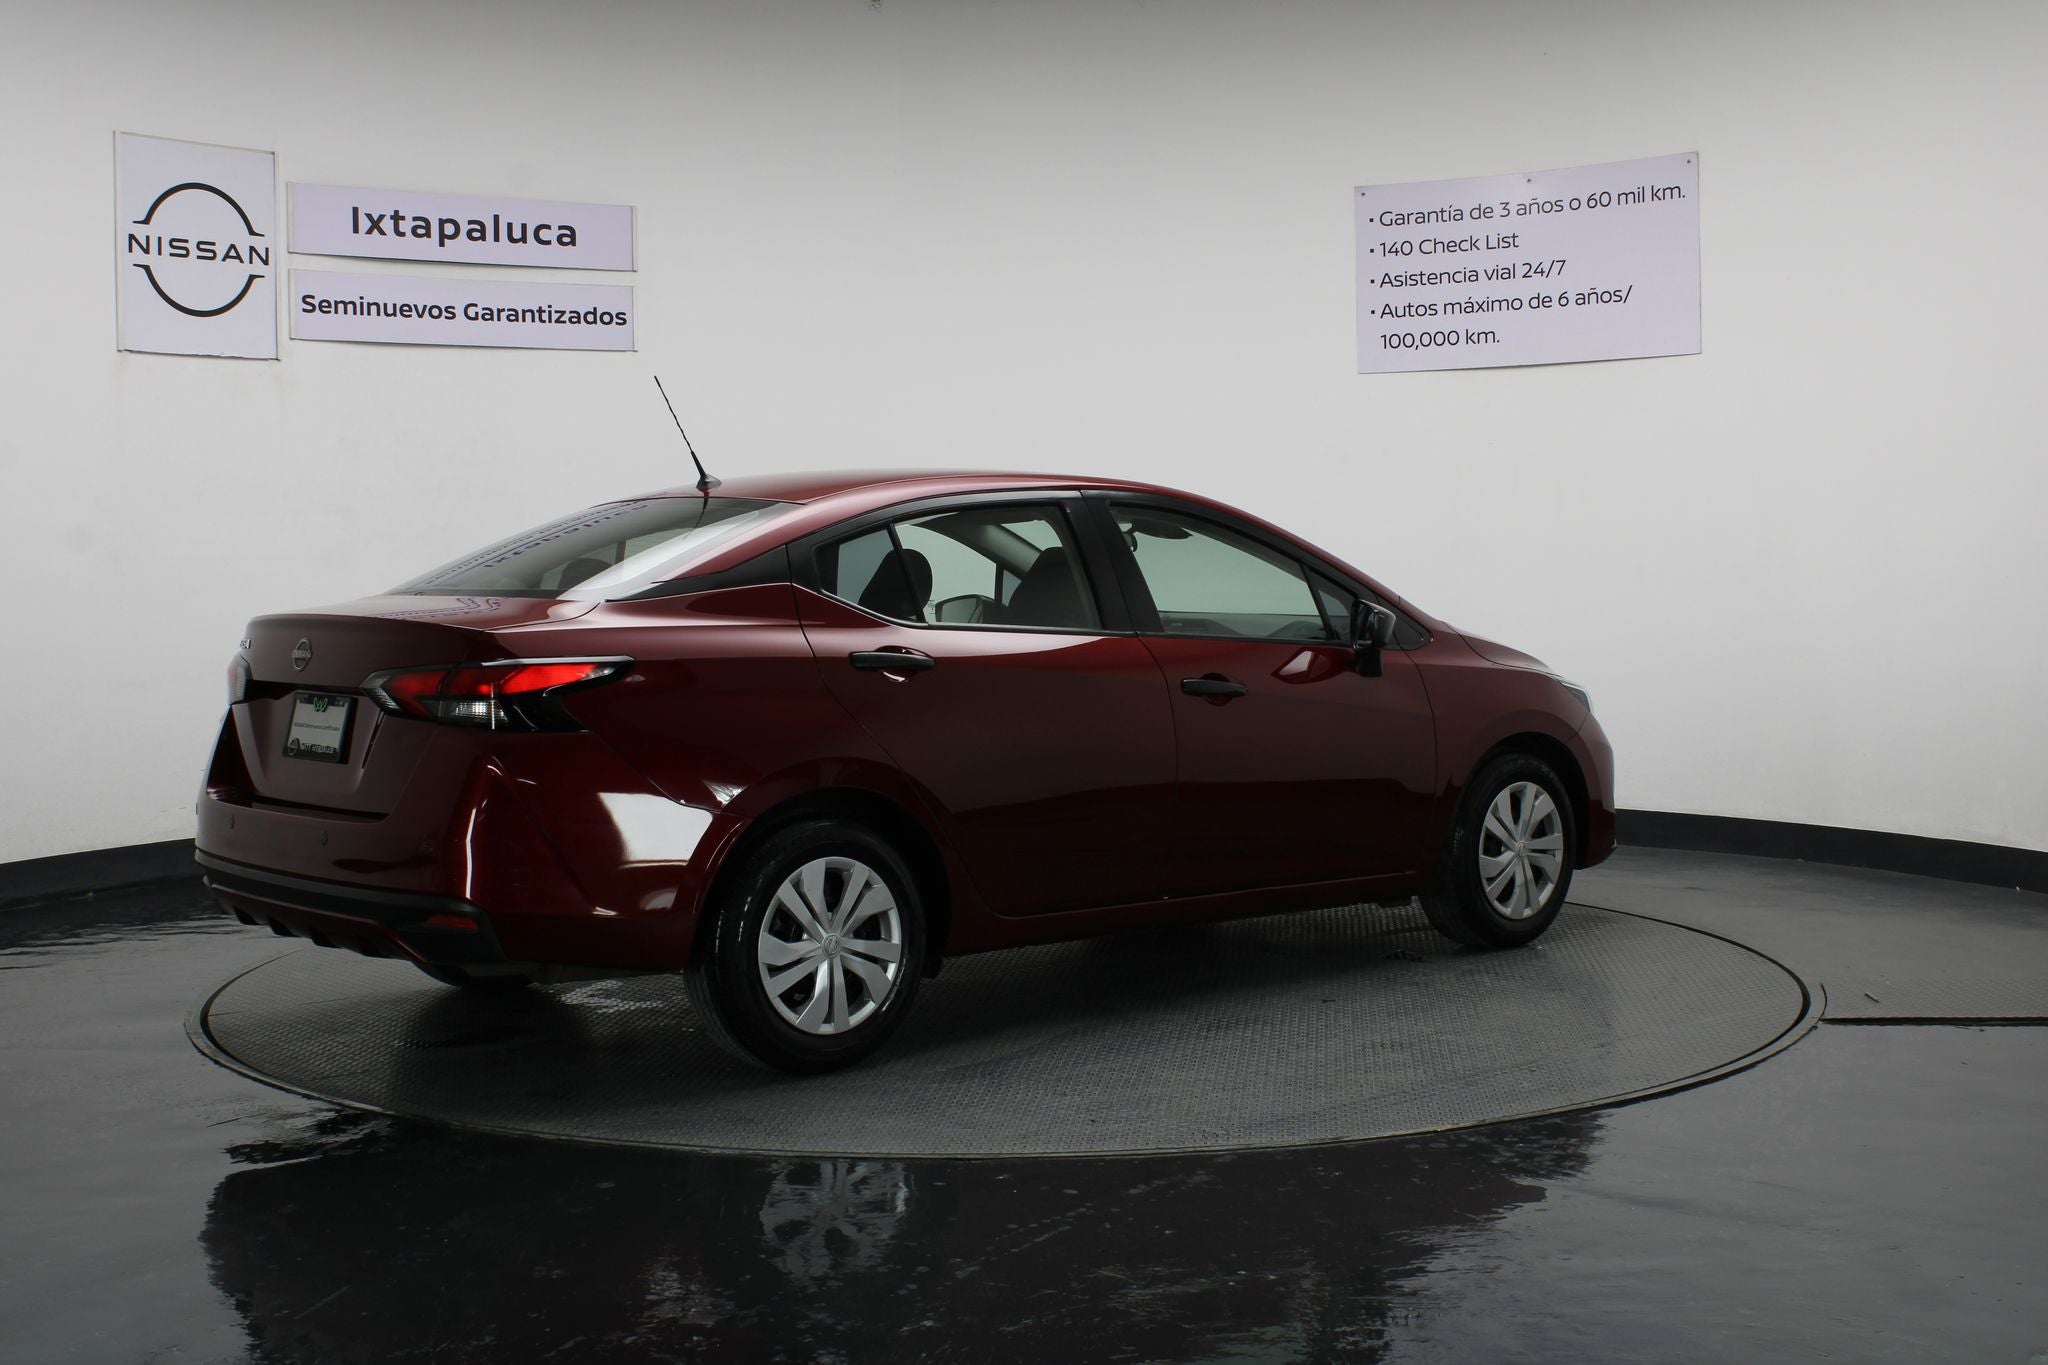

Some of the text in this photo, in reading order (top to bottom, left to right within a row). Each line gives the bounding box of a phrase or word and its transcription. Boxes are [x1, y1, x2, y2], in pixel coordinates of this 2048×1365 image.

[1379, 184, 1686, 227] Garantía de 3 años o 60 mil km.
[352, 206, 577, 248] Ixtapaluca
[127, 232, 270, 267] NISSAN
[1379, 232, 1520, 258] 140 Check List
[1379, 259, 1567, 289] Asistencia vial 24/7
[301, 294, 628, 326] Seminuevos Garantizados
[1380, 284, 1633, 319] Autos máximo de 6 años/
[1380, 328, 1501, 351] 100,000 km.
